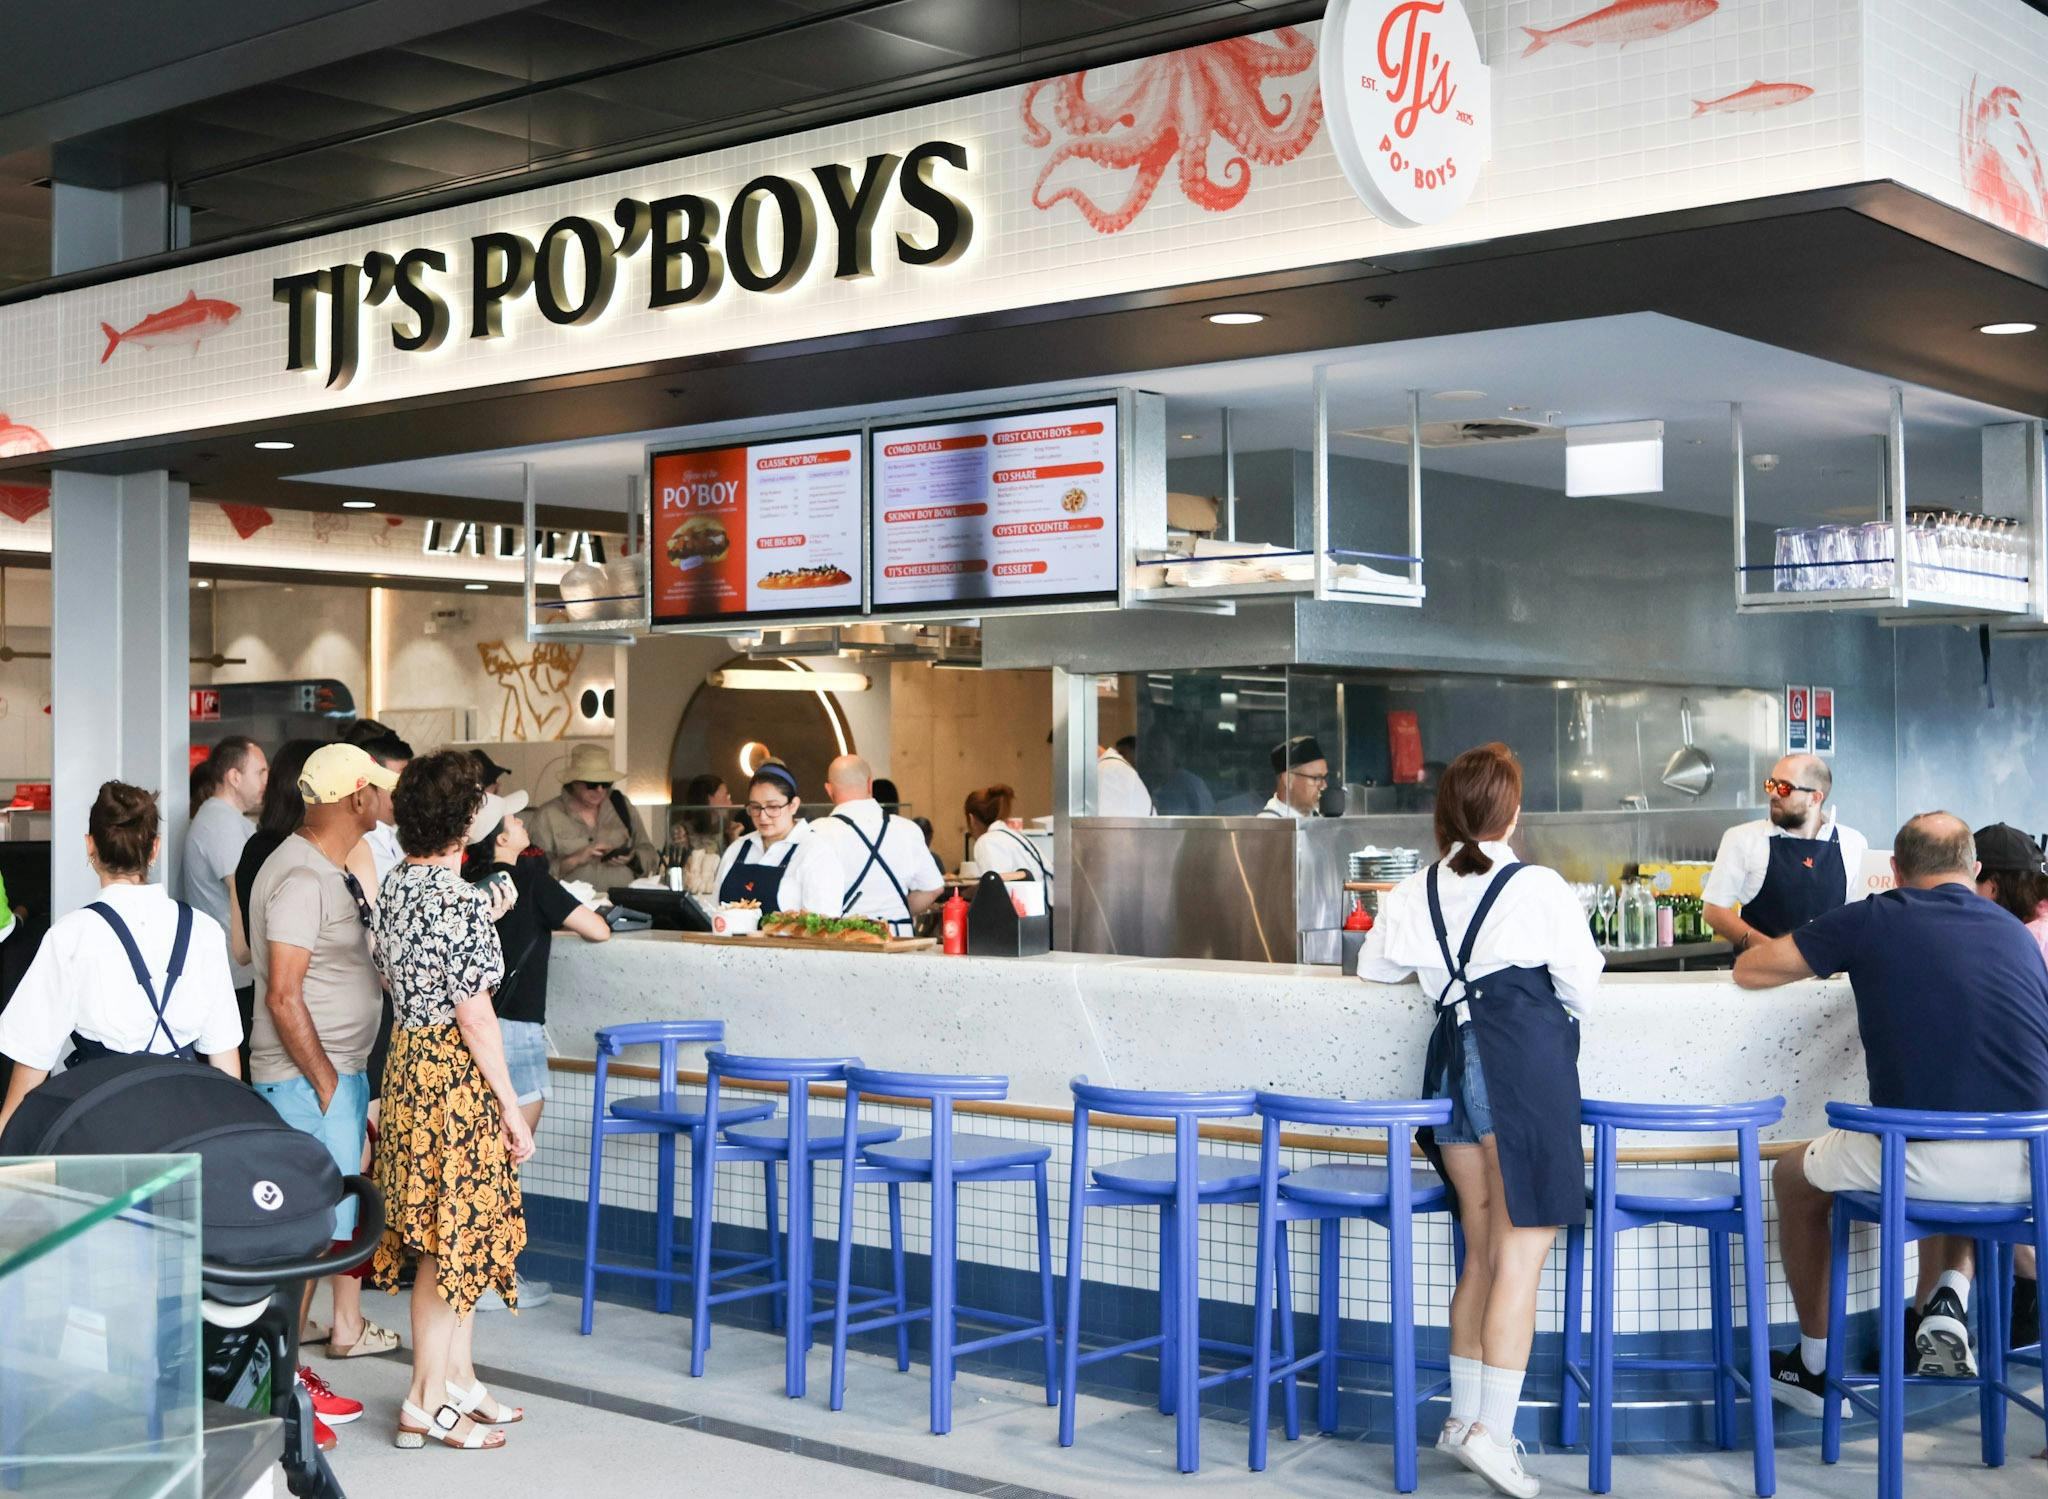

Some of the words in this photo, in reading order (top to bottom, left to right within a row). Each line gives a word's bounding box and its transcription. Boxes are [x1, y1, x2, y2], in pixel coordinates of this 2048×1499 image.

[1377, 0, 1457, 139] TJ's
[1361, 76, 1379, 92] EST.
[1456, 110, 1474, 126] 2025
[1414, 157, 1457, 190] BOYS
[273, 248, 449, 391] TJ'S
[470, 140, 973, 339] PO'BOYS
[997, 433, 1020, 444] FIRST
[1020, 429, 1049, 441] CATCH
[1049, 426, 1072, 437] BOYS
[887, 445, 917, 456] COMBO
[917, 441, 942, 452] DEALS
[760, 456, 789, 469] CLASSIC
[997, 472, 1009, 482] TO
[1009, 470, 1037, 480] SHARE
[888, 511, 916, 522] SKINNY
[917, 509, 934, 520] BOY
[934, 507, 957, 518] BOWL
[996, 525, 1028, 536] OYSTER
[1028, 521, 1069, 533] COUNTER
[760, 538, 774, 548] THE
[775, 537, 787, 547] BIG
[787, 536, 803, 546] BOY
[887, 567, 903, 578] TJ'S
[903, 563, 964, 576] CHEESEBURGER
[997, 564, 1033, 575] DESSERT
[1777, 1369, 1800, 1383] HOKA
